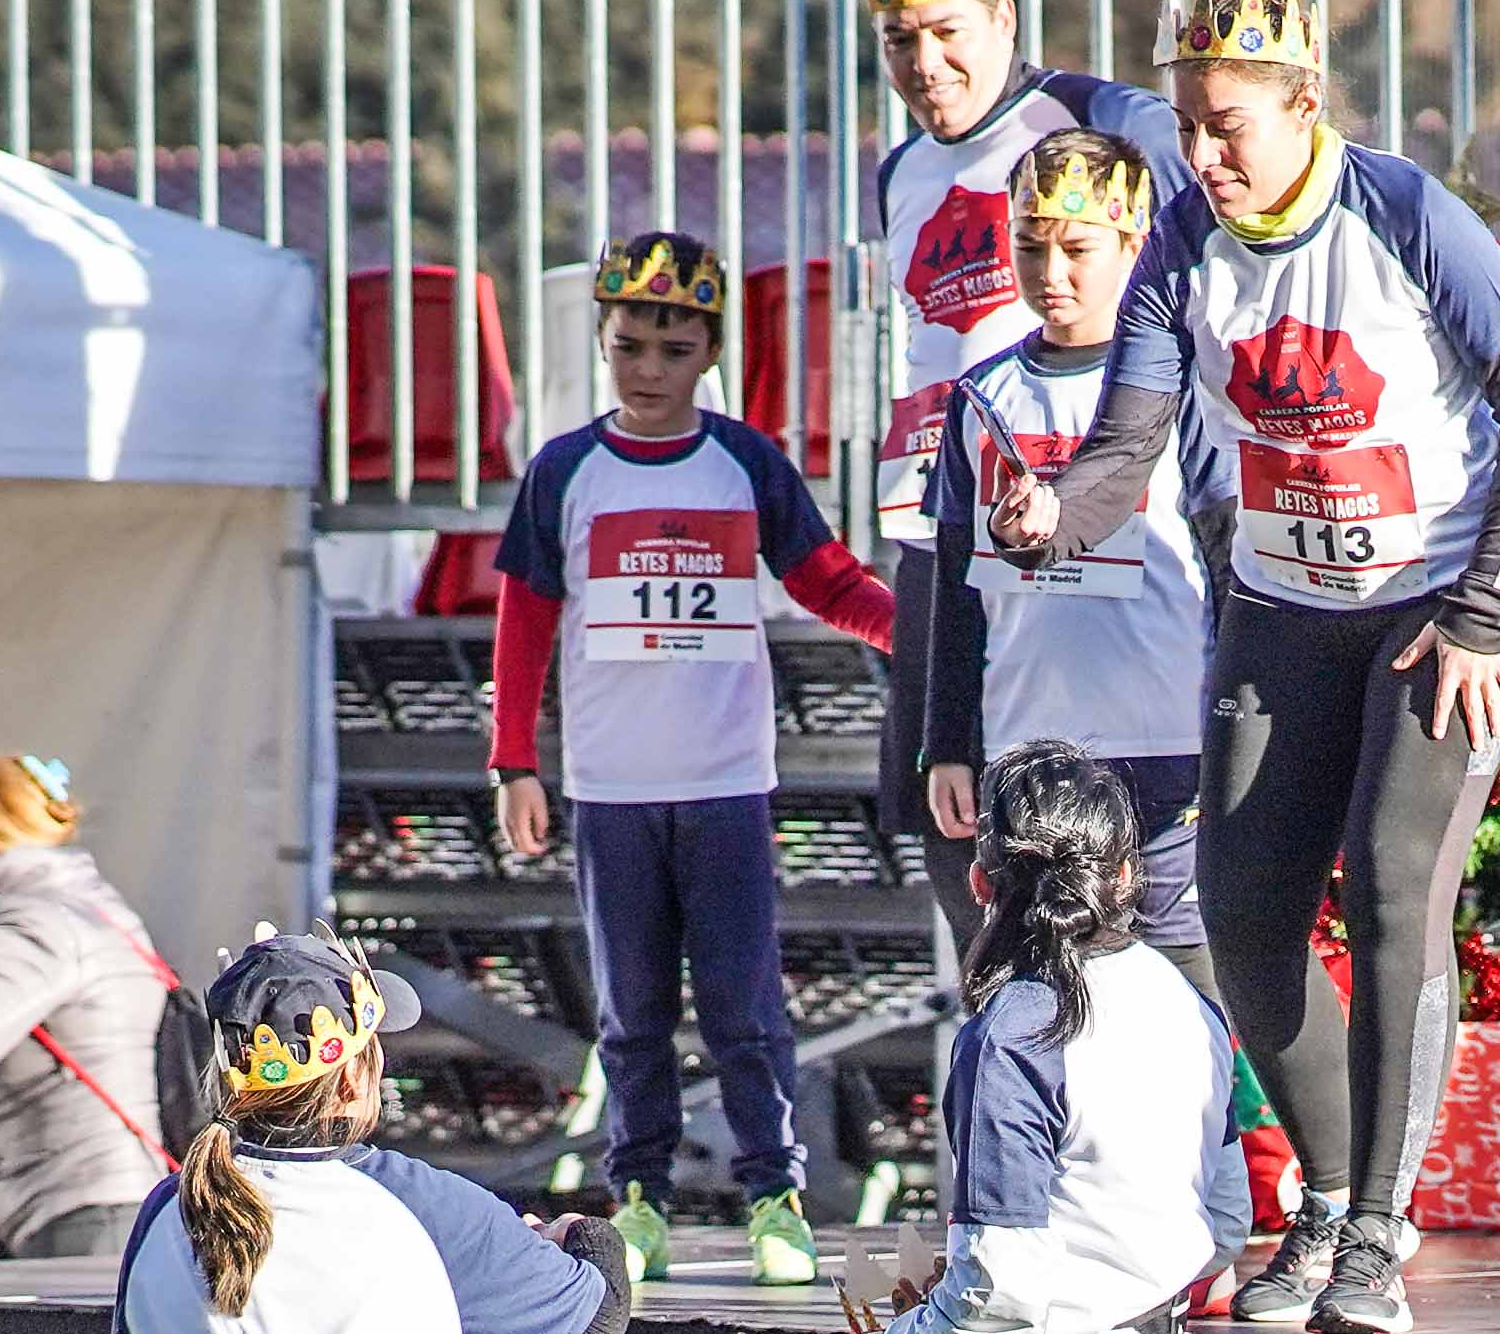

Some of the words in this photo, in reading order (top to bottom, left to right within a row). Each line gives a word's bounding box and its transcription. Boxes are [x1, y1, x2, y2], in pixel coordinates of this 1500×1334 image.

[1302, 402, 1350, 415] POPULAR
[1307, 410, 1367, 432] MAGOS
[1274, 486, 1320, 515] REYES
[1320, 492, 1381, 520] MAGOS
[1286, 519, 1376, 564] 113
[619, 551, 669, 574] REYES
[673, 552, 725, 575] MAGOS
[632, 580, 718, 621] 112
